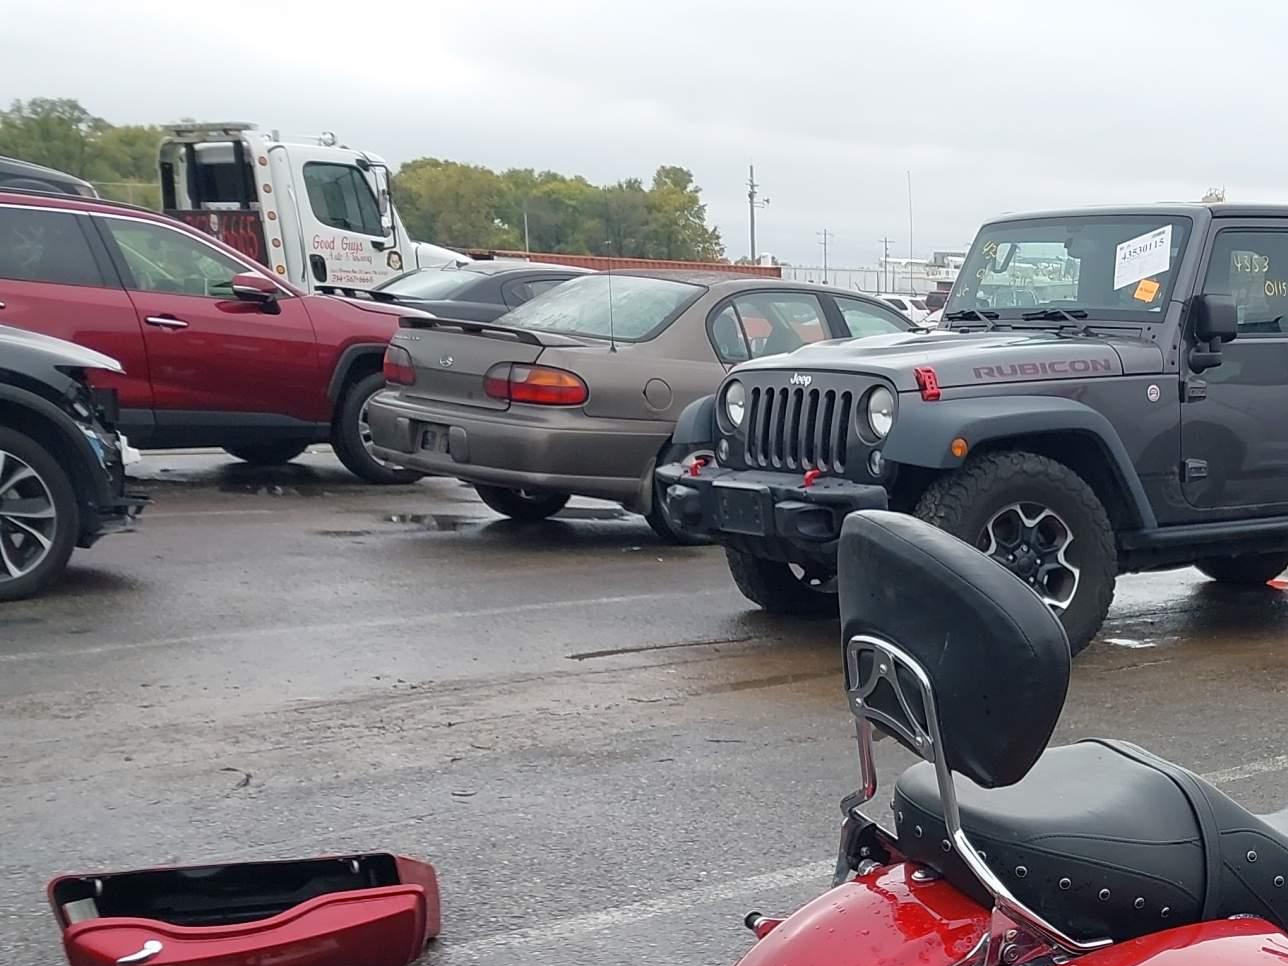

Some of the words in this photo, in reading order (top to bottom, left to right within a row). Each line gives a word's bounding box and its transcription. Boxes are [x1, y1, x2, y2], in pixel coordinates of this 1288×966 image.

[312, 234, 335, 250] Good
[341, 236, 363, 254] Guys
[1233, 255, 1269, 273] 4353
[1264, 280, 1287, 297] 0115
[973, 359, 1112, 379] RUBICON
[790, 372, 812, 387] Jeep
